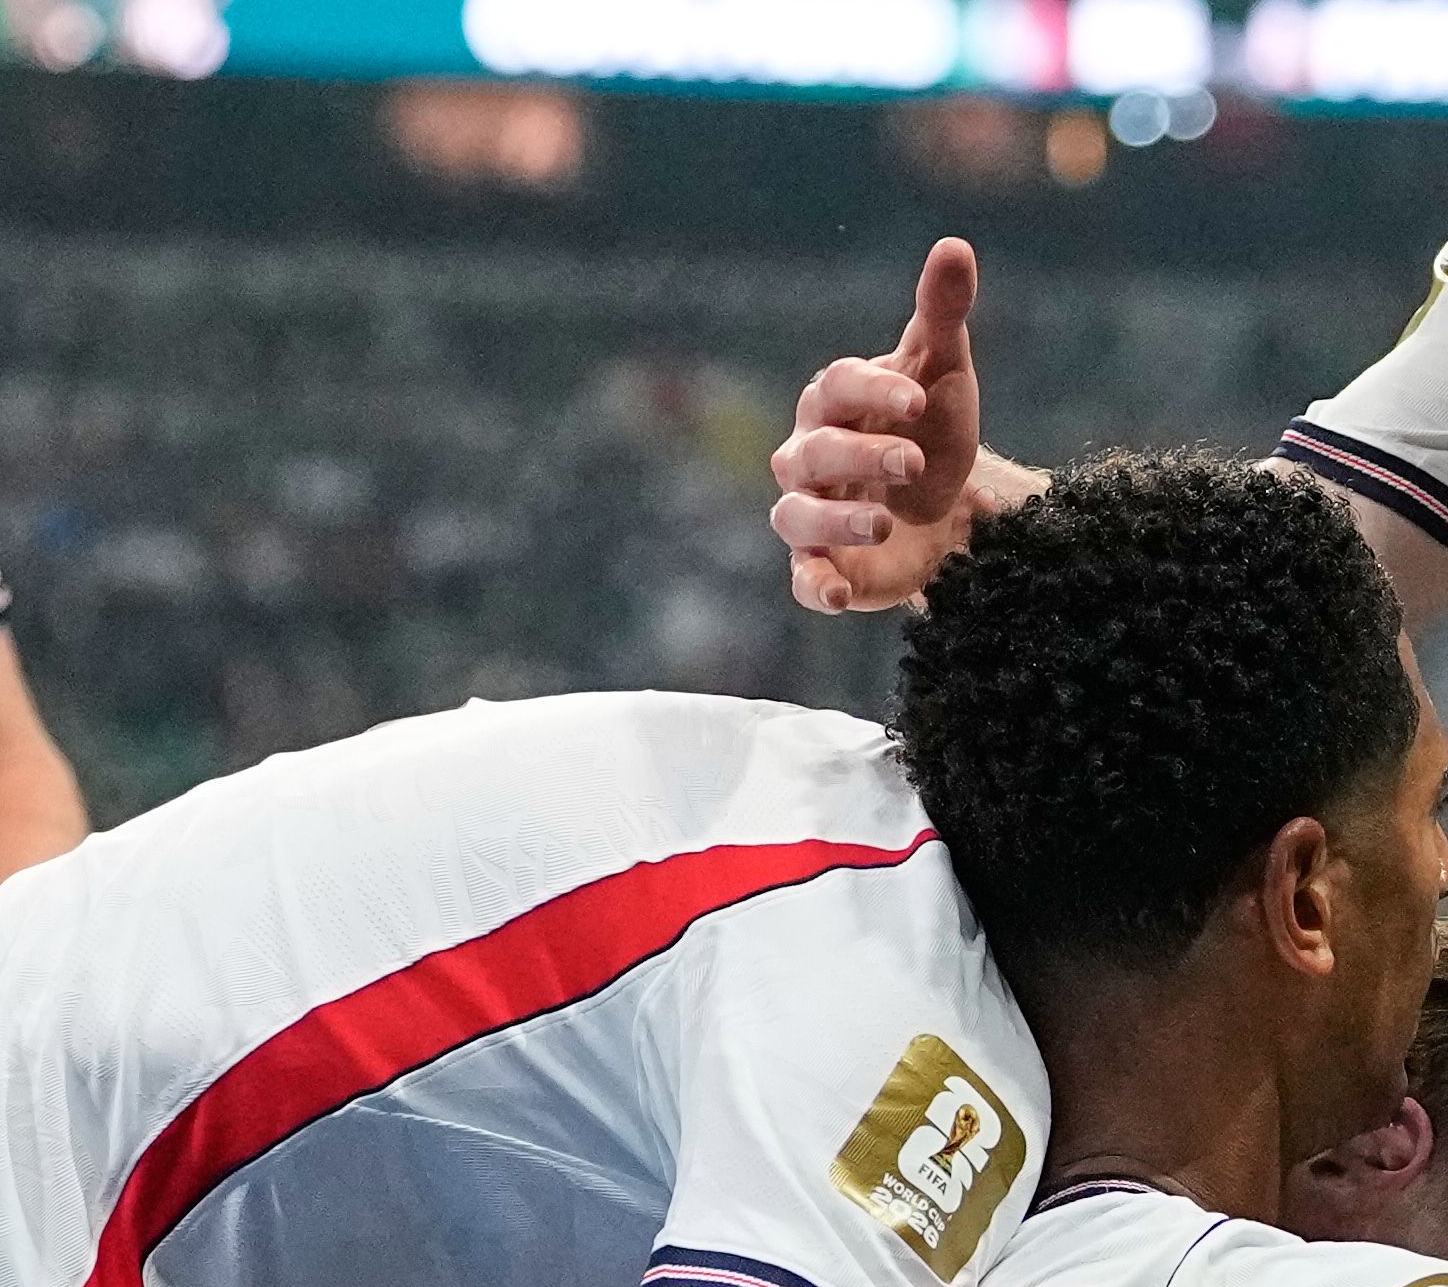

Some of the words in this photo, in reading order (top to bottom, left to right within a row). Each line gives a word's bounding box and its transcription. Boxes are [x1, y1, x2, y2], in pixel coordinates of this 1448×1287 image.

[882, 1172, 929, 1211] WORLD
[928, 1207, 946, 1232] CUP
[918, 1162, 948, 1196] FIFA
[869, 1186, 940, 1250] 2026
